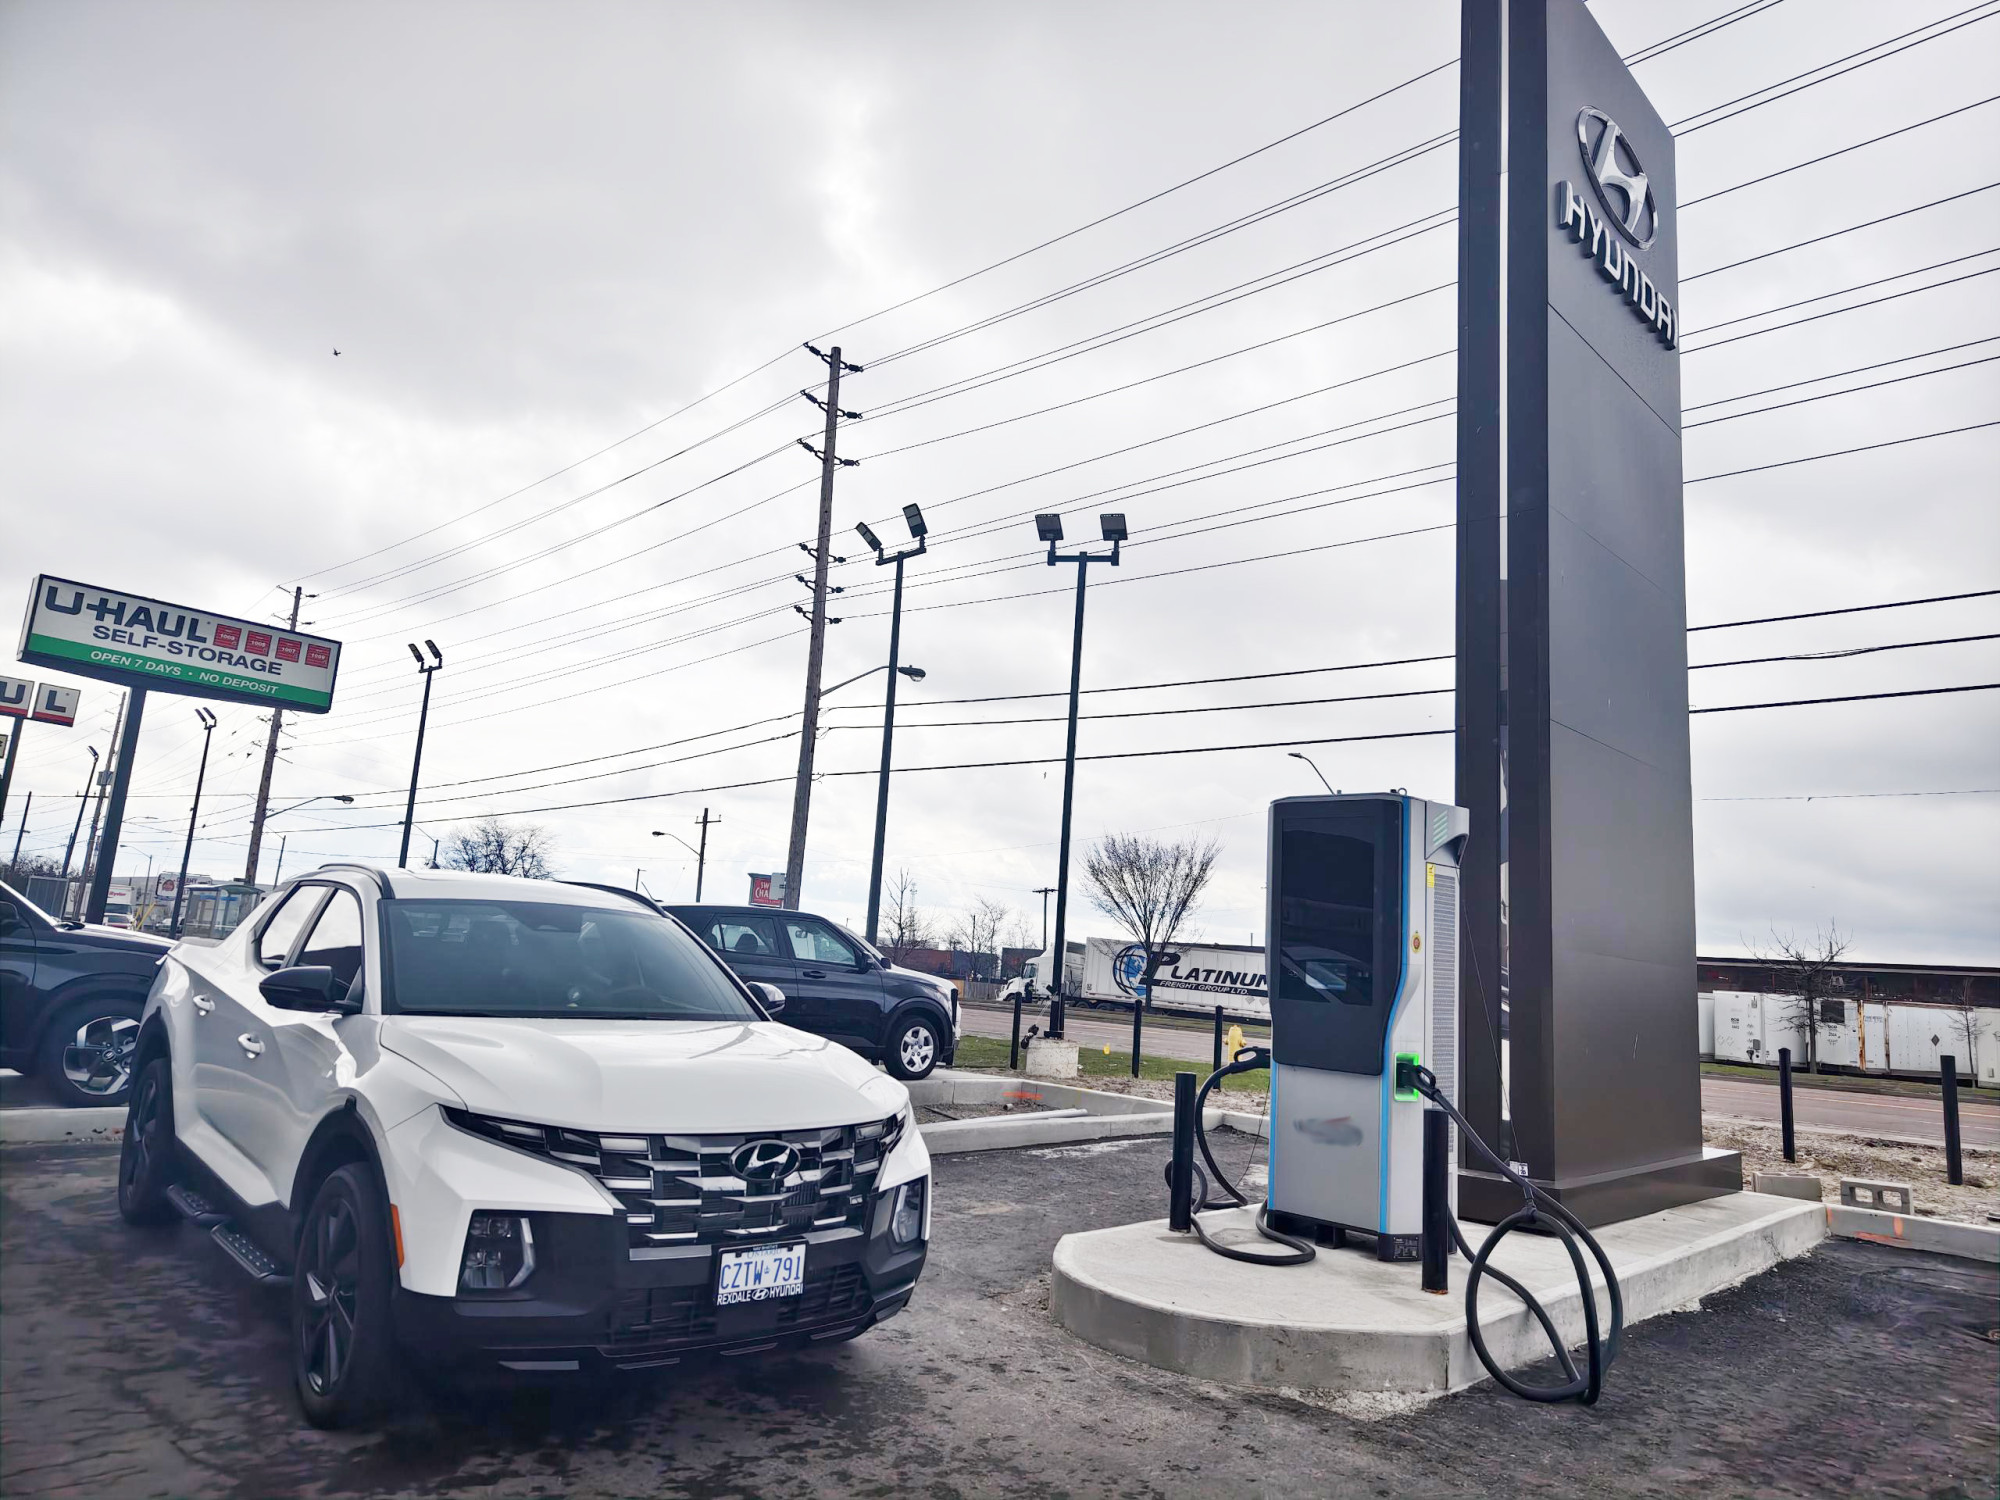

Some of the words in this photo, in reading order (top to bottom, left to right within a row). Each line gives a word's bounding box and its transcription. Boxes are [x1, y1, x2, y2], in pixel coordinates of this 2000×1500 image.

[1557, 180, 1678, 350] HYUNDAI
[44, 585, 208, 644] U-HAUL
[90, 650, 132, 667] OPEN
[134, 657, 144, 668] 7
[144, 661, 182, 676] DAYS
[199, 671, 219, 683] NO
[222, 675, 279, 694] DEPOSIT
[92, 625, 283, 675] SELF-STORAGE
[1159, 980, 1198, 990] FREIGHT
[1198, 984, 1231, 993] GROUP
[716, 1290, 752, 1306] REXDALE
[769, 1283, 804, 1298] HYUNDAI
